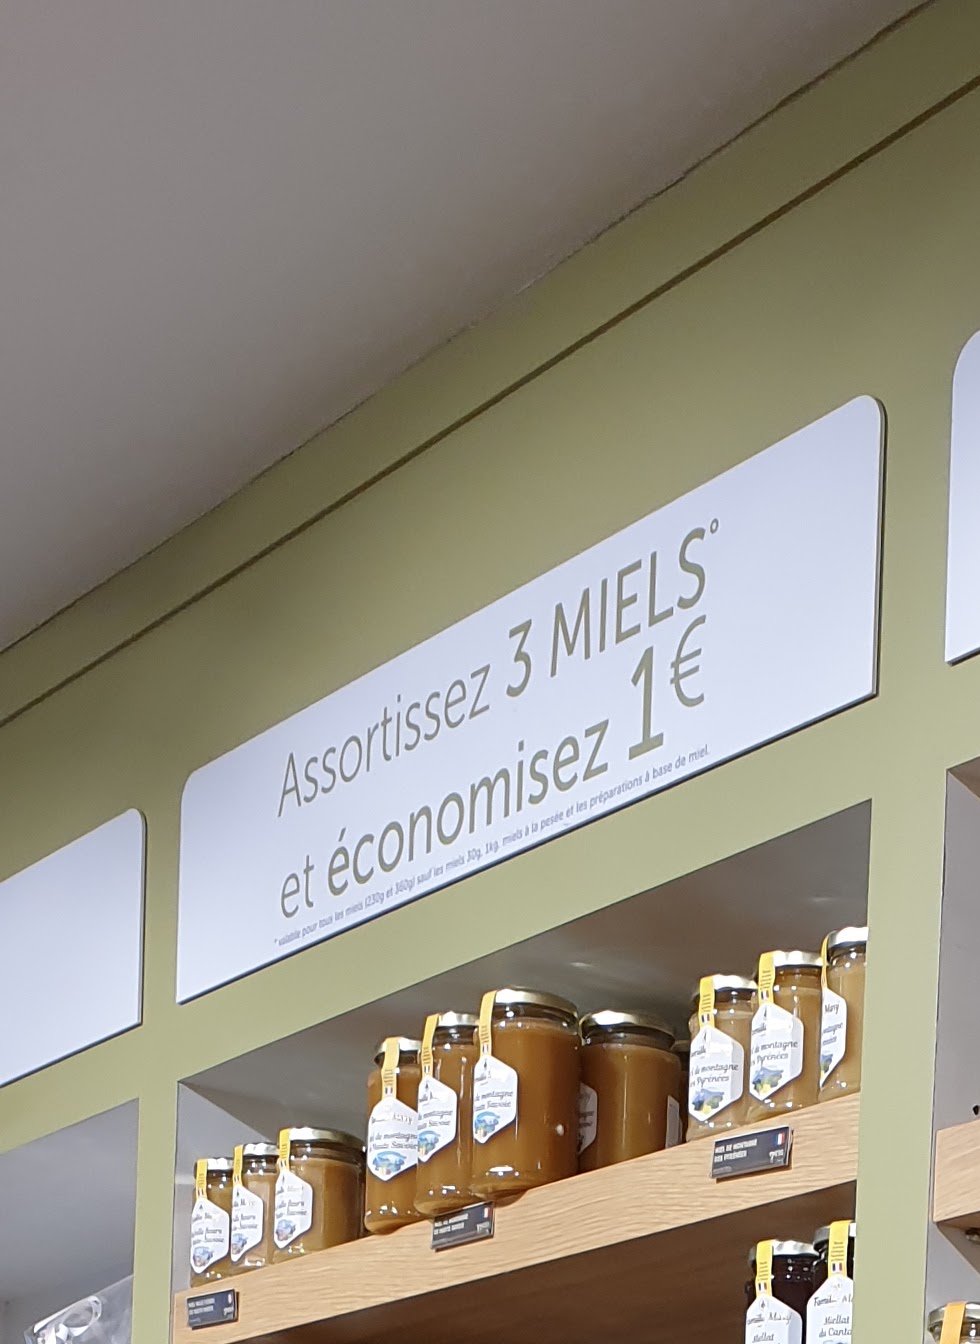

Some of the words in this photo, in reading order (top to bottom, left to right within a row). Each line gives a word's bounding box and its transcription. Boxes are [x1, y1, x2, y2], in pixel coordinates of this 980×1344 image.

[277, 664, 490, 817] Assortissez
[506, 618, 533, 697] 3
[281, 855, 314, 918] et
[327, 718, 609, 896] économisez
[627, 614, 706, 760] 1€
[302, 923, 317, 937] pour
[319, 917, 333, 928] tous
[335, 909, 344, 920] les
[345, 903, 363, 915] miels
[386, 887, 393, 898] et
[417, 869, 432, 886] sauf
[433, 864, 443, 877] les
[446, 854, 464, 872] miels
[502, 828, 522, 846] miels
[525, 824, 529, 836] à
[531, 820, 538, 833] la
[541, 809, 564, 831] pesée
[566, 805, 574, 818] et
[576, 800, 587, 814] les
[589, 777, 642, 810] préparations
[645, 770, 650, 782] à
[652, 763, 673, 779] base
[675, 755, 686, 769] de
[757, 1051, 789, 1064] Pyrénées
[761, 1039, 798, 1051] montagne
[824, 1316, 850, 1326] Miellat
